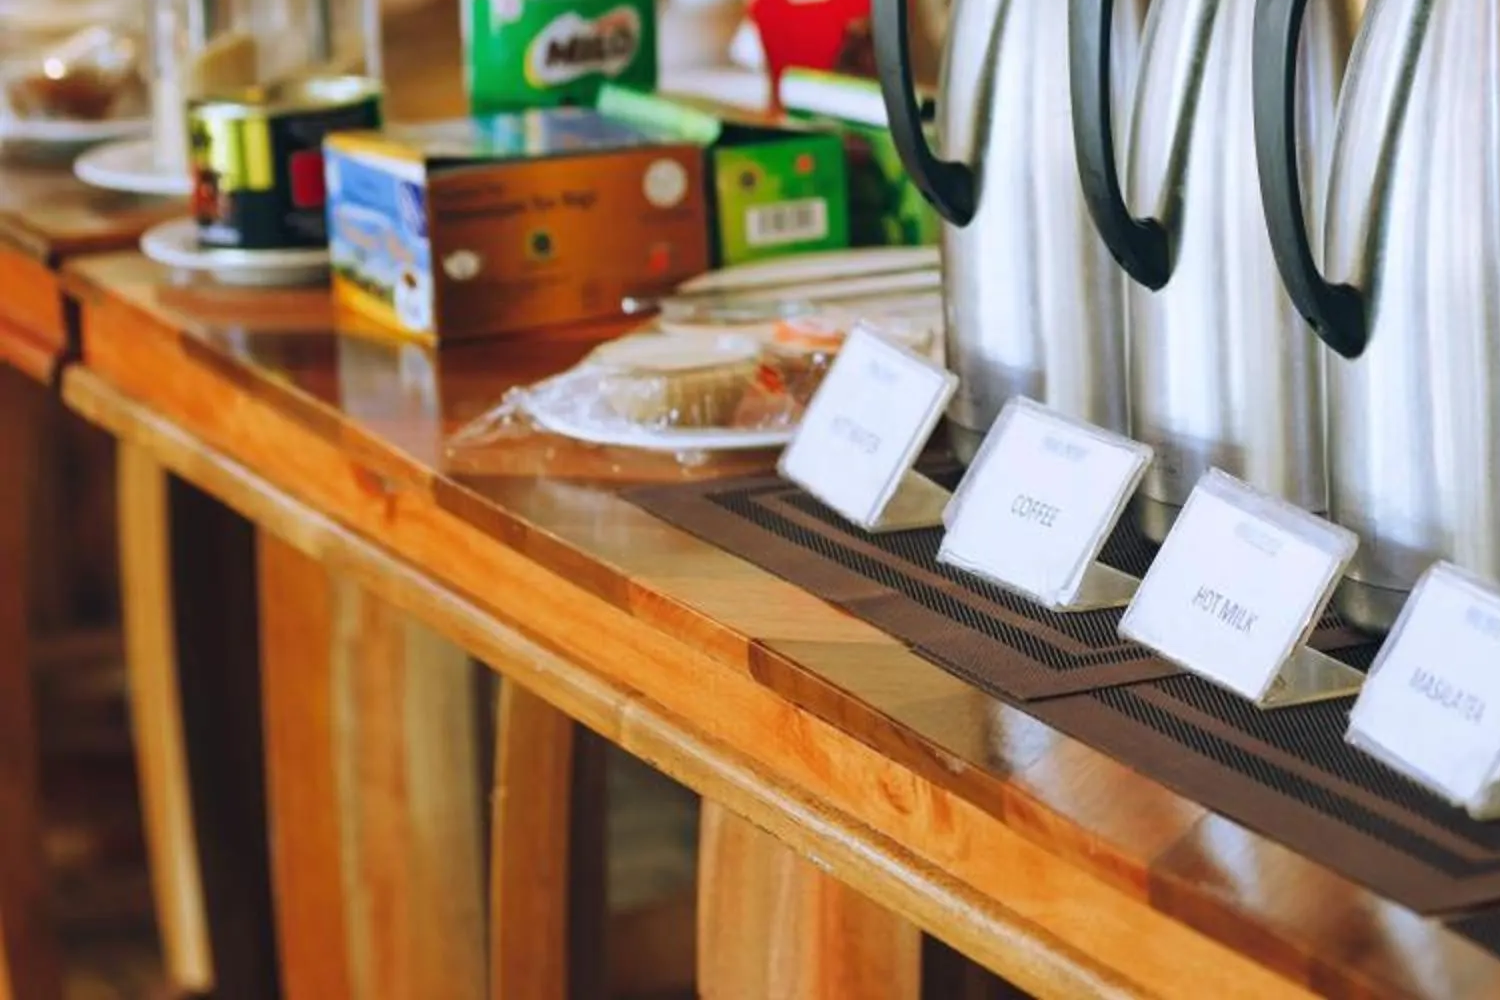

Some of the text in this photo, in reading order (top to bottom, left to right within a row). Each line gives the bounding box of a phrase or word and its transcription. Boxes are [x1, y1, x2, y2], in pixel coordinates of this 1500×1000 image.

[545, 21, 636, 68] MILO
[1011, 493, 1061, 527] COFFEE
[1191, 583, 1258, 633] HOT MILK
